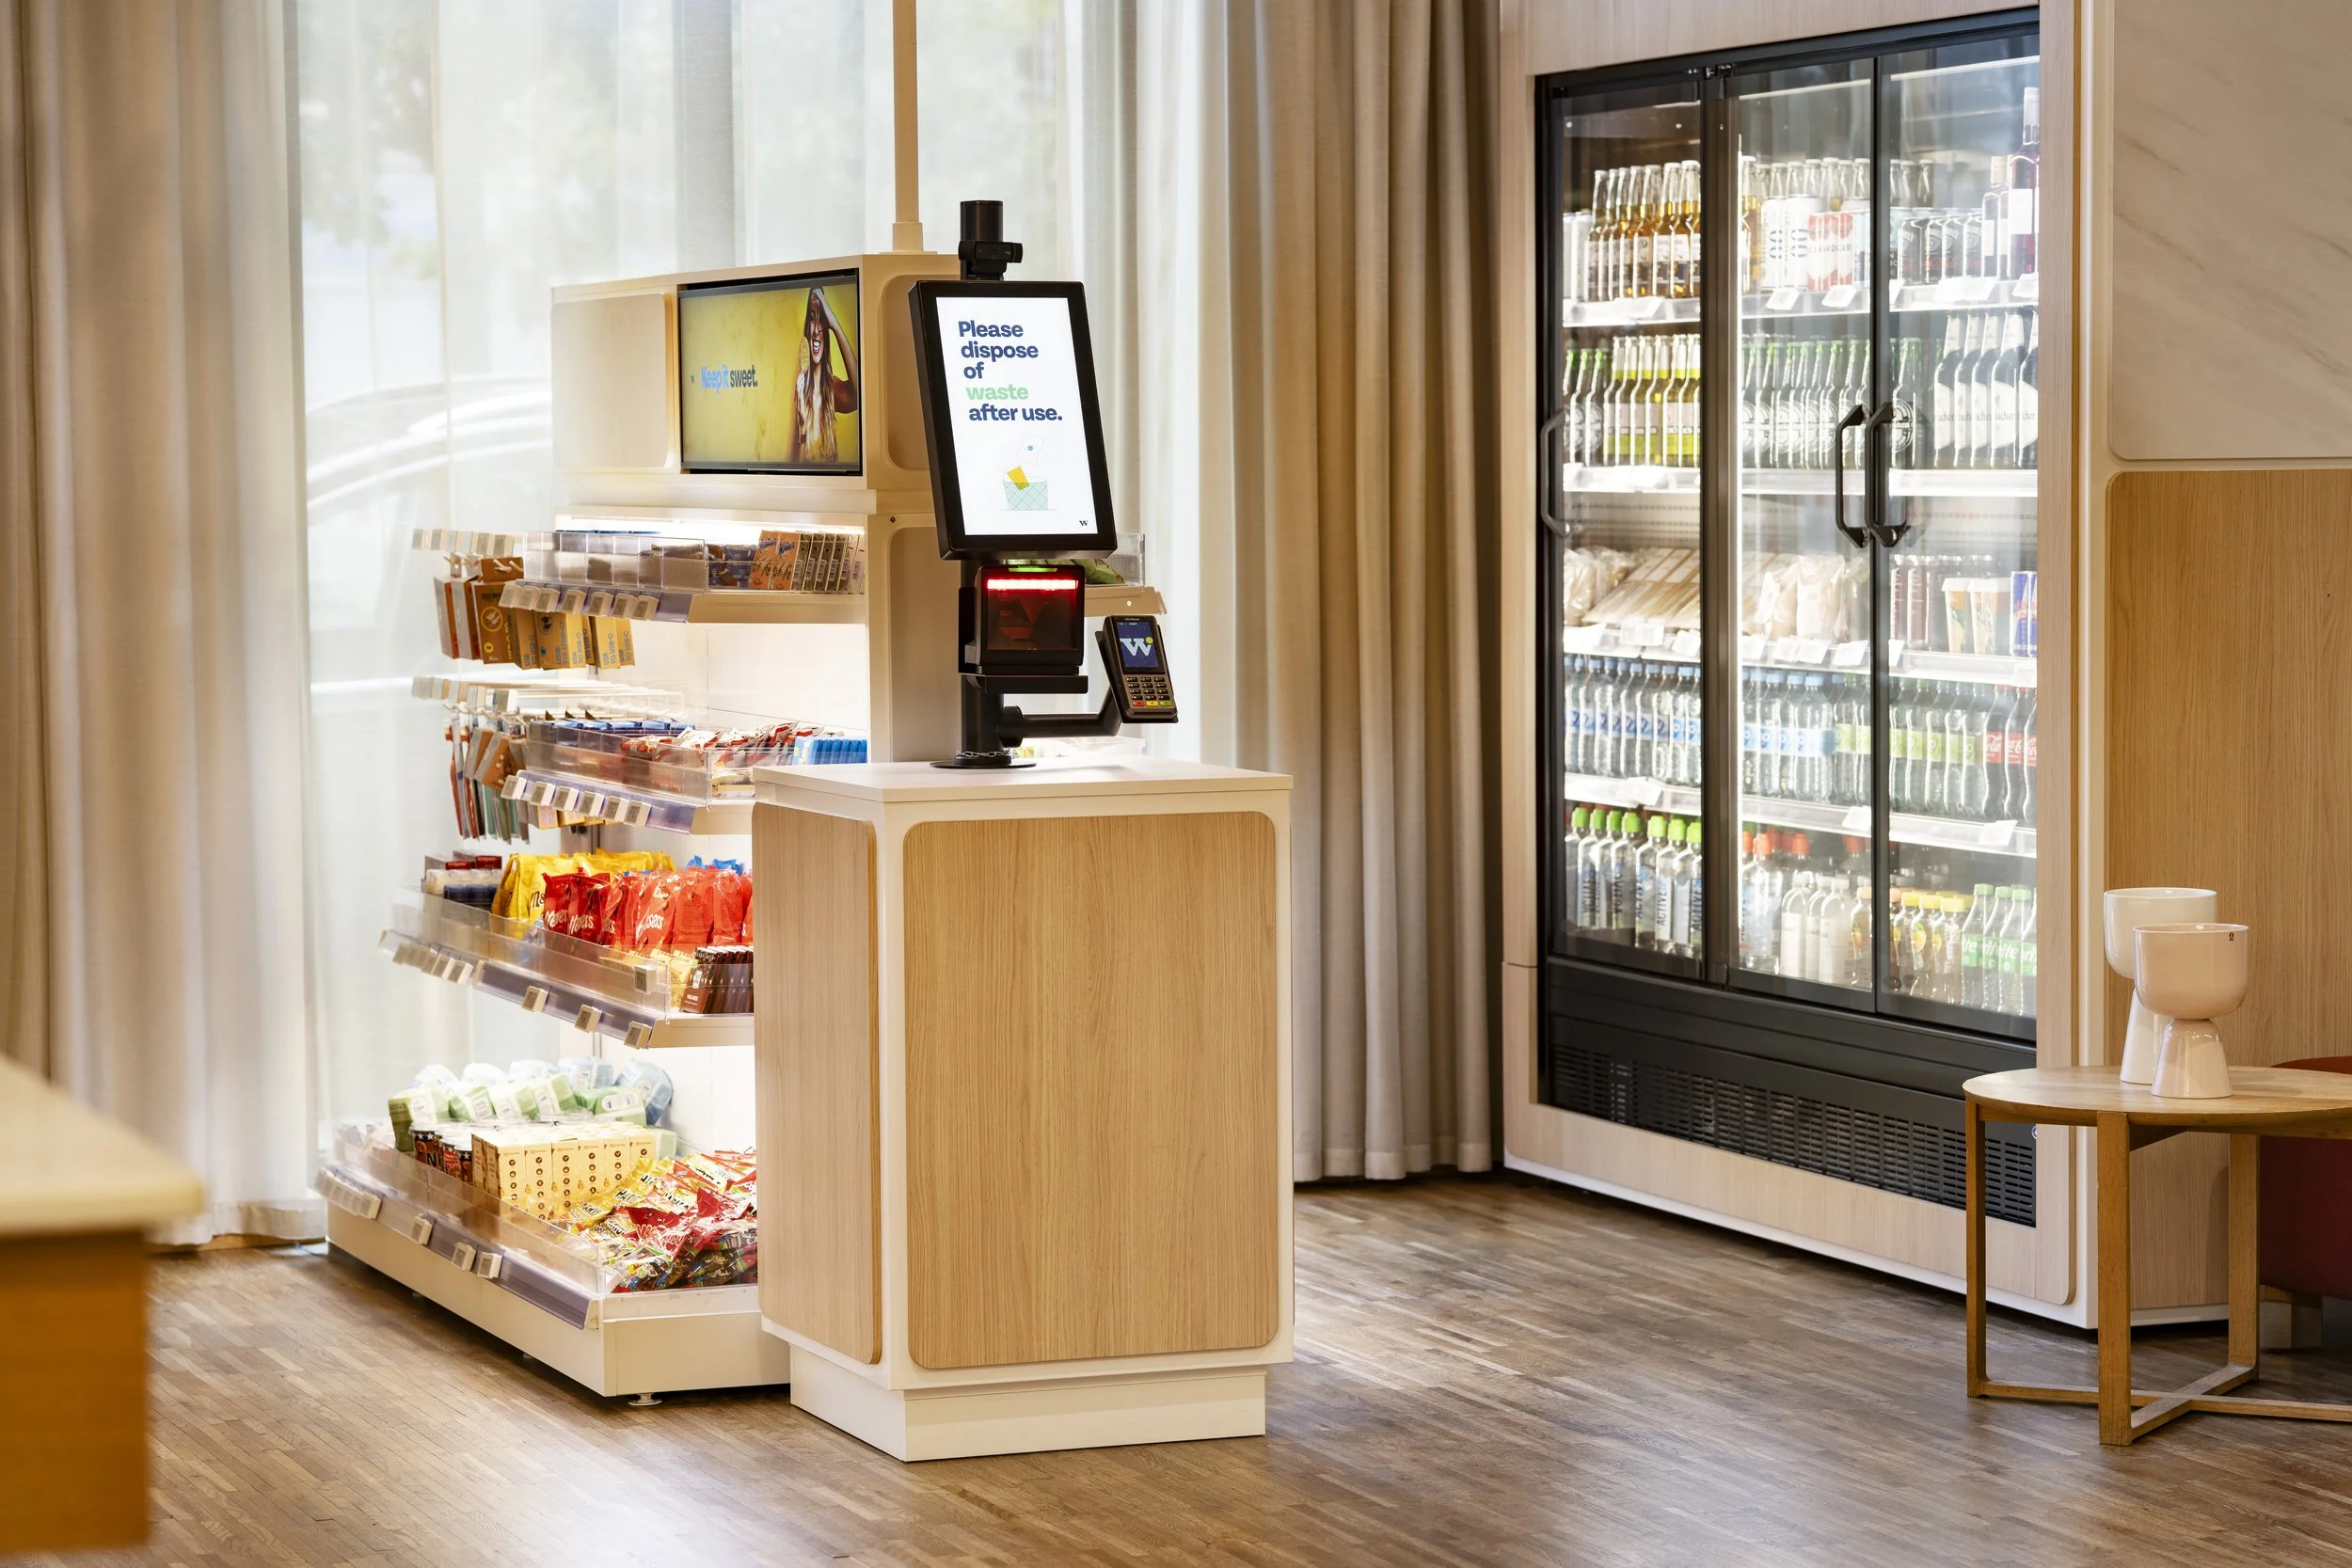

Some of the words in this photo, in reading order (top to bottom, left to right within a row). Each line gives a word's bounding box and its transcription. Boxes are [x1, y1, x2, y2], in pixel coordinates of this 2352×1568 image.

[958, 320, 1024, 338] Please
[961, 341, 1039, 363] dispose
[700, 365, 723, 394] Keep
[723, 363, 729, 388] it
[729, 364, 758, 388] sweet.
[963, 361, 985, 379] of
[965, 384, 1029, 401] waste
[968, 403, 1019, 421] after
[1021, 407, 1063, 421] use.
